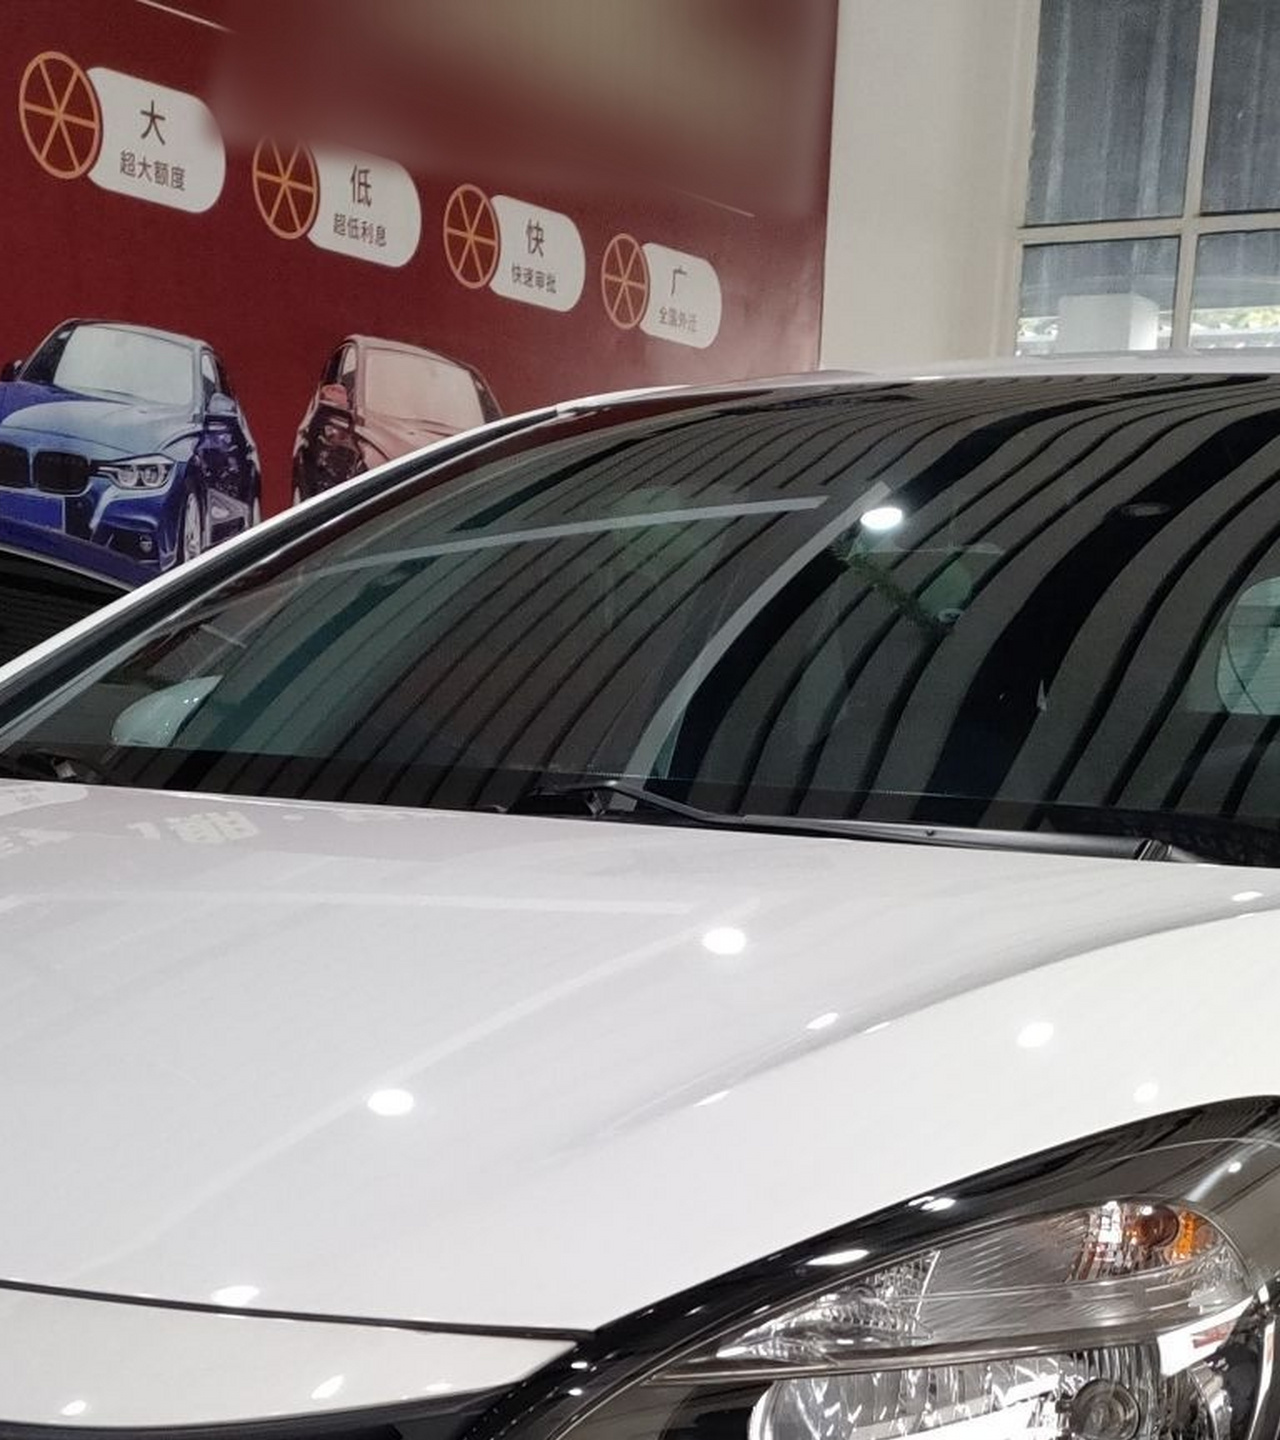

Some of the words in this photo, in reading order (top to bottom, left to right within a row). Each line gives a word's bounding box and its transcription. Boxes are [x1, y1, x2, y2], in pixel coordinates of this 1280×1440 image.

[139, 99, 166, 146] 大
[120, 149, 186, 191] 超大额度
[350, 164, 372, 208] 低
[333, 213, 387, 247] 超低利息
[526, 218, 545, 258] 快
[671, 266, 688, 297] 广
